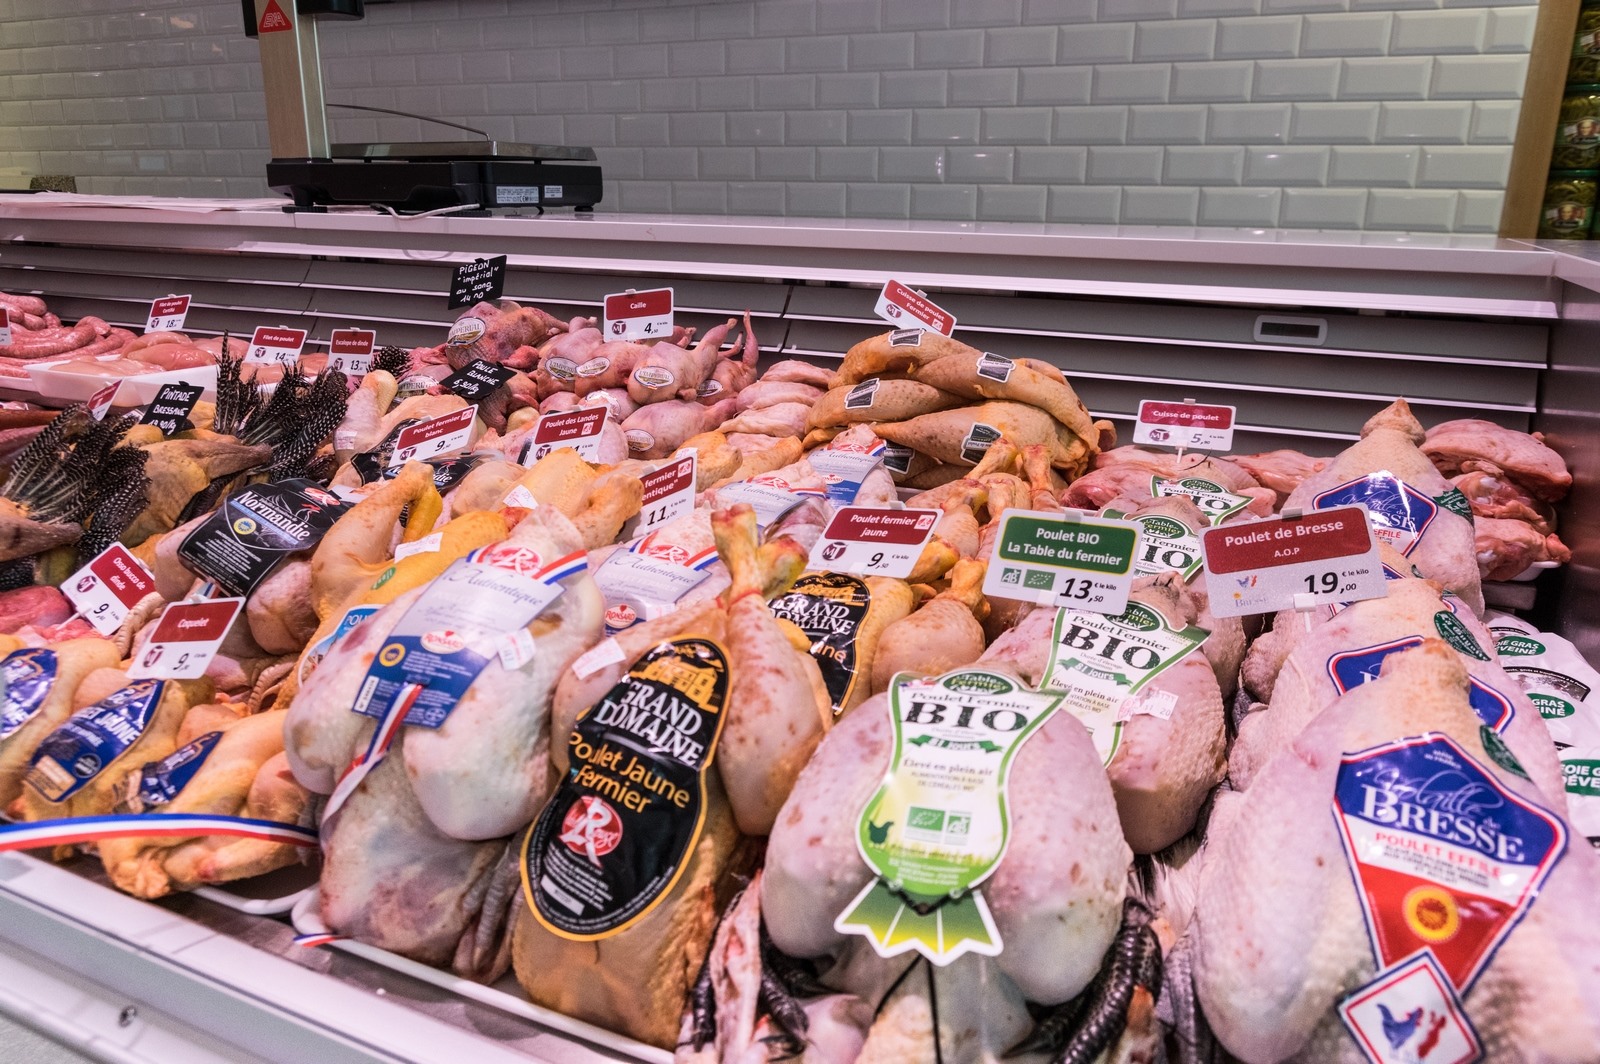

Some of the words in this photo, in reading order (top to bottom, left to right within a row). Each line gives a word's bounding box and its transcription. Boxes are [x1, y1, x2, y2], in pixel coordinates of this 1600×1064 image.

[629, 301, 647, 310] Caille
[896, 288, 916, 303] Cuisse
[916, 300, 925, 309] de
[925, 306, 945, 322] poulet
[906, 303, 930, 320] Fermier
[472, 361, 499, 374] POULE
[466, 370, 500, 386] BLANCHE
[545, 419, 565, 429] Poulet
[565, 417, 576, 426] des
[577, 413, 599, 424] Landes
[1153, 410, 1179, 418] Cuisse
[1192, 412, 1219, 422] poulet
[413, 423, 435, 435] Poulet
[435, 415, 461, 428] fermier
[425, 428, 444, 438] blanc
[559, 427, 577, 437] Jaune
[645, 470, 676, 488] fermier
[642, 479, 679, 500] entique"
[234, 490, 311, 541] Normandie
[850, 514, 879, 524] Poulet
[880, 515, 916, 526] fermier
[860, 527, 888, 538] jaune
[1036, 528, 1075, 542] Poulet
[1077, 532, 1100, 545] BIO
[1224, 532, 1272, 548] Poulet
[1274, 526, 1292, 540] de
[1295, 519, 1345, 536] Bresse
[1007, 541, 1021, 553] La
[1023, 543, 1055, 557] Table
[1057, 547, 1073, 560] du
[1075, 549, 1122, 566] fermier
[1151, 537, 1198, 553] Fermier
[1273, 546, 1301, 558] A.O.P
[867, 552, 889, 569] 9,50
[1141, 543, 1194, 568] IO
[113, 557, 126, 571] Osso
[123, 565, 141, 586] bucco
[135, 580, 147, 592] de
[1356, 568, 1370, 576] kilo
[109, 575, 126, 591] dinde
[1059, 577, 1104, 603] 13,50
[1105, 583, 1117, 591] kilo
[177, 617, 209, 630] Coquelet
[605, 610, 635, 621] RONSARD
[1072, 614, 1114, 634] Poulet
[1115, 627, 1170, 652] Fermier
[1057, 623, 1161, 670] BIO
[1511, 640, 1539, 650] GRAS
[1088, 668, 1115, 680] jours
[1051, 677, 1073, 689] Élevé
[1084, 687, 1106, 700] plein
[1106, 695, 1119, 704] air
[620, 682, 703, 736] GRAND
[911, 692, 963, 703] Poulet
[967, 695, 1032, 710] Fermier
[1531, 698, 1565, 709] GRAS
[903, 701, 1029, 732] BIO
[94, 712, 142, 746] JAUNE
[593, 699, 705, 767] DOMAINE
[948, 762, 976, 774] plein
[574, 765, 653, 813] Fermier
[620, 756, 690, 808] Jaune
[1358, 783, 1525, 863] BRESSE
[1375, 831, 1442, 856] POULET
